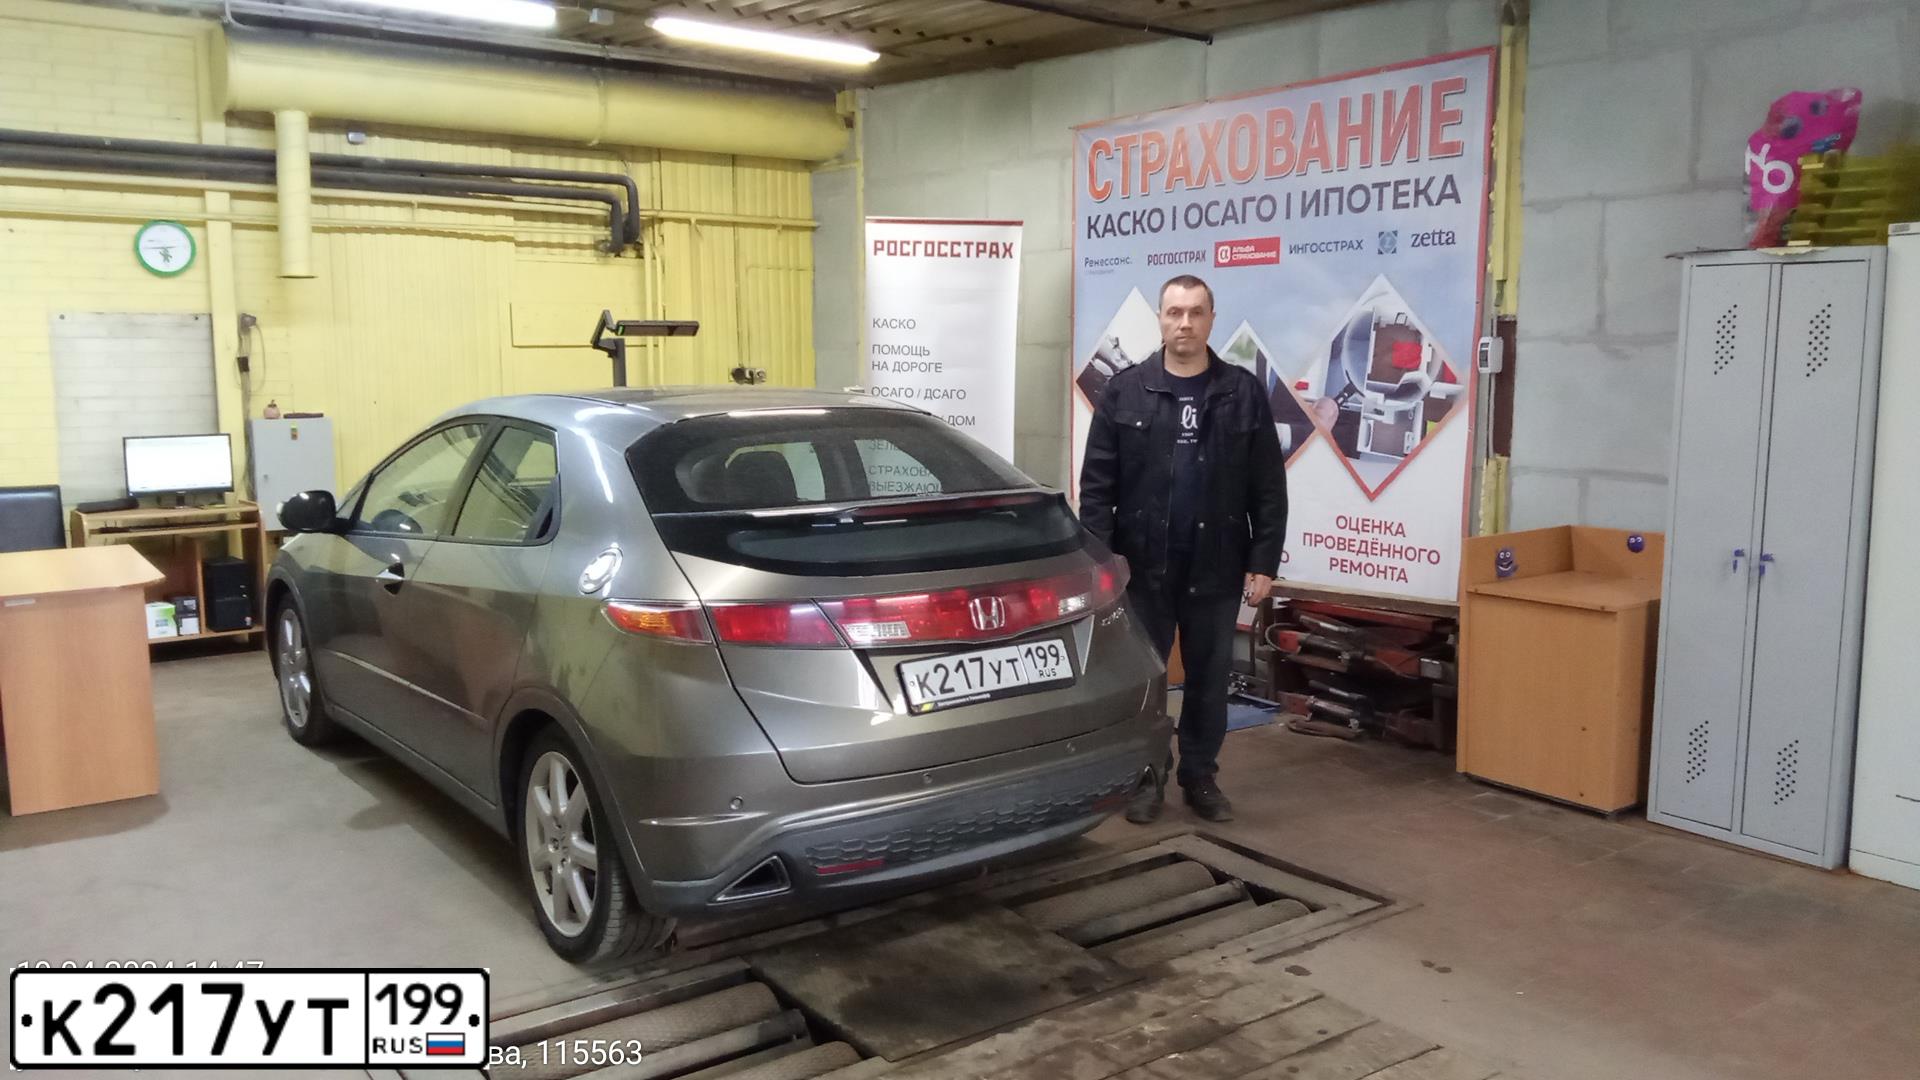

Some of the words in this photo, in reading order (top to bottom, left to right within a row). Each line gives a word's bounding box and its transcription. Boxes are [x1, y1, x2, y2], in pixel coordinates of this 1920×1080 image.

[1087, 76, 1467, 203] СТРАХОВАНИЕ
[1087, 204, 1164, 239] КАСКО
[1184, 194, 1278, 231] ОСАГО
[1300, 173, 1462, 219] ИПОТЕКА
[1411, 228, 1456, 248] zetta
[873, 239, 1014, 259] РОСГОССТРАХ
[1289, 239, 1364, 255] ИНГОССТРАХ
[1147, 250, 1207, 267] РОСГОССТРАХ
[872, 318, 916, 330] КАСКО
[872, 344, 930, 357] ПОМОЩЬ
[871, 361, 889, 373] НА
[892, 361, 943, 374] ДОРОГЕ
[871, 386, 914, 399] ОСАГО
[923, 388, 966, 401] ДСАГО
[947, 415, 976, 426] ДОМ
[1180, 404, 1198, 429] li
[868, 440, 899, 451] ЗЕЛ
[868, 465, 935, 478] СТРАХОВ
[1335, 514, 1406, 538] ОЦЕНКА
[1303, 533, 1440, 565] ПРОВЕДЁННОГО
[1329, 557, 1408, 583] РЕМОНТА
[1024, 643, 1060, 668] 199
[1039, 668, 1057, 678] RUS
